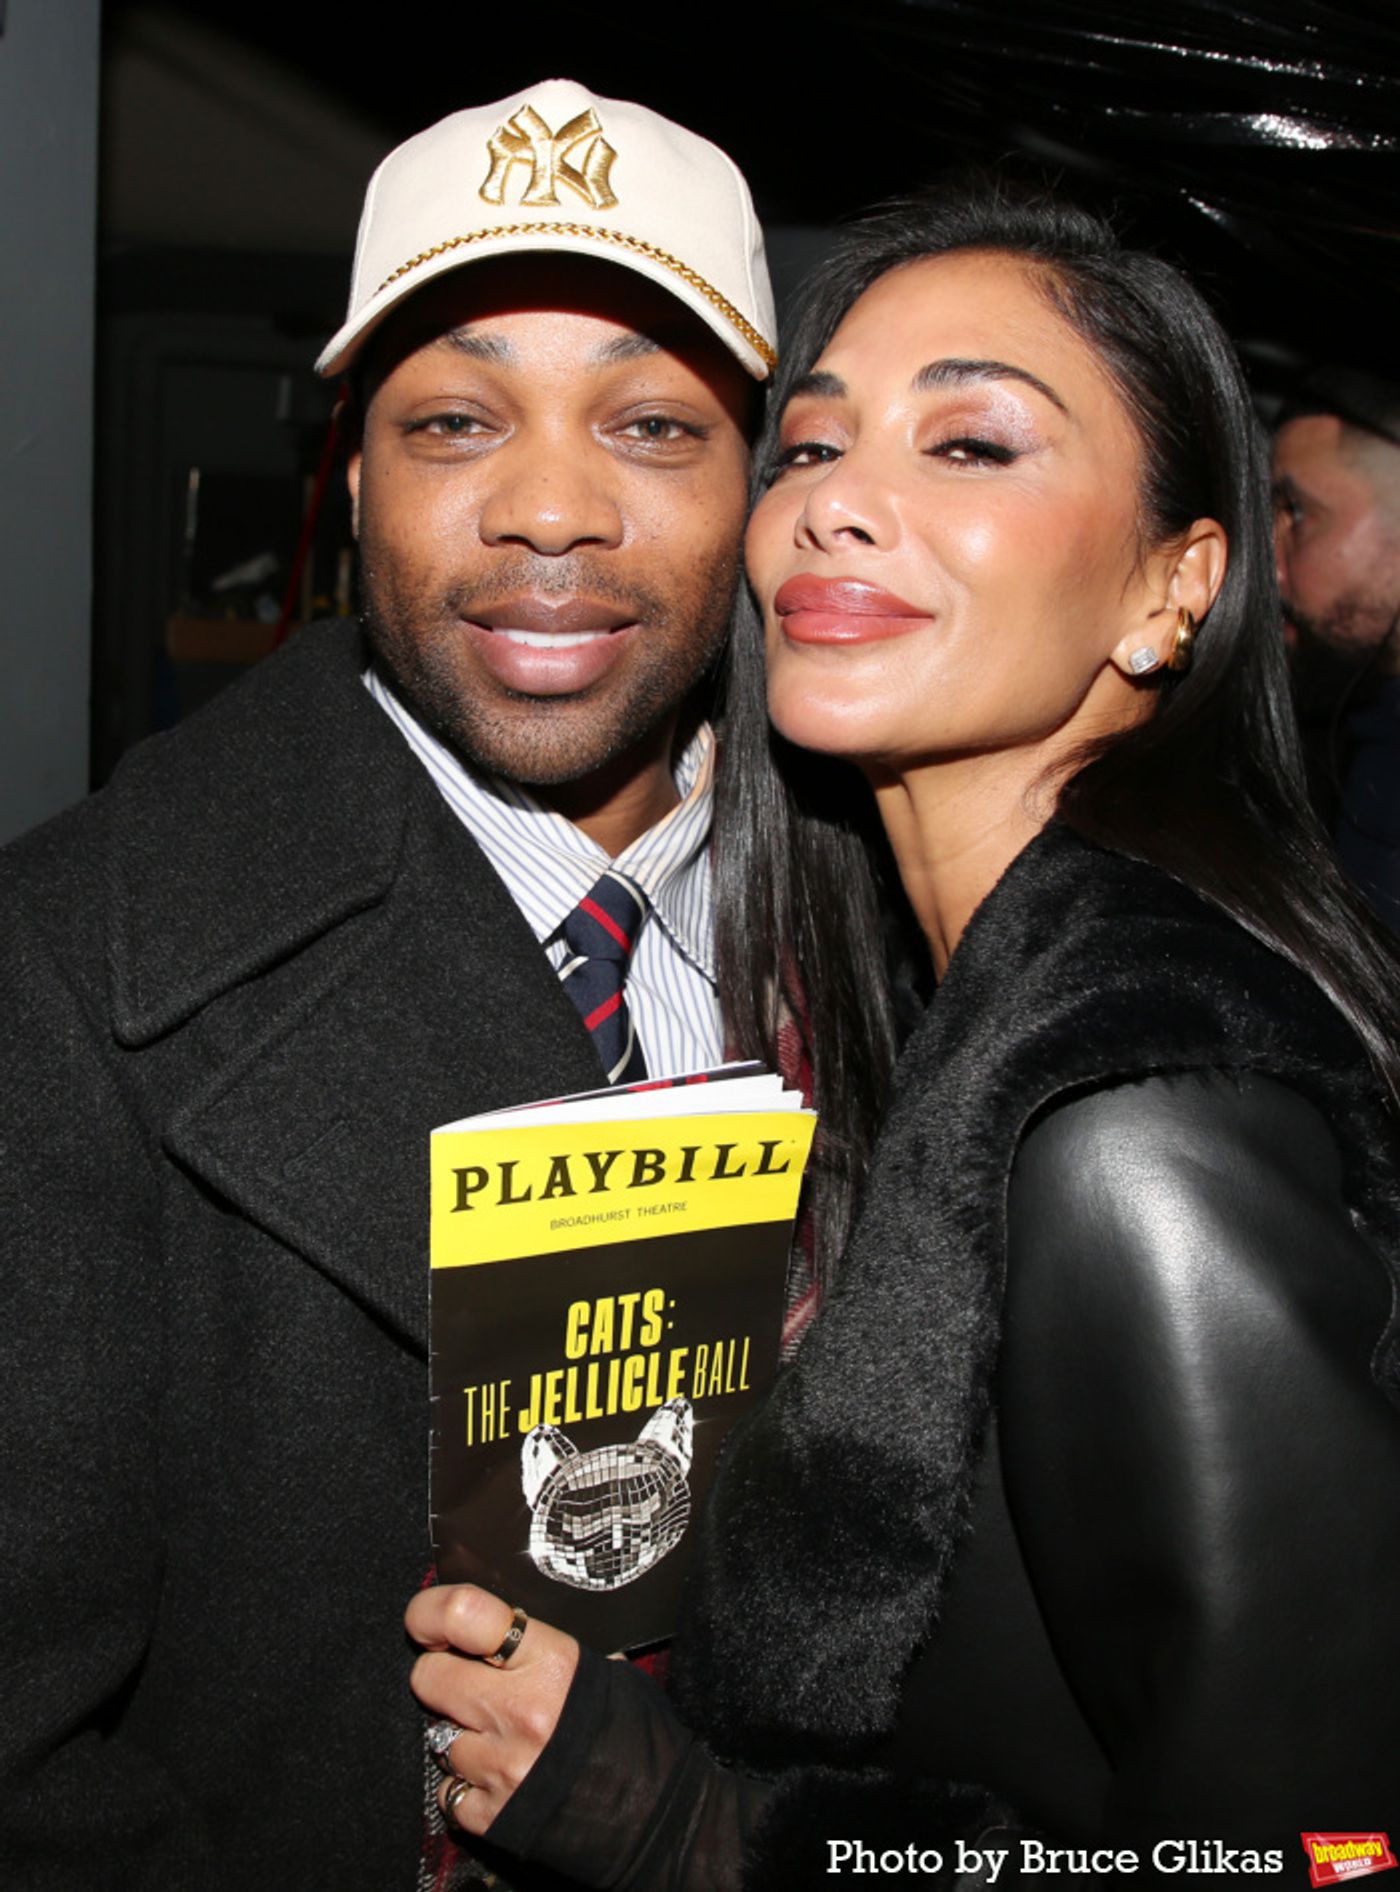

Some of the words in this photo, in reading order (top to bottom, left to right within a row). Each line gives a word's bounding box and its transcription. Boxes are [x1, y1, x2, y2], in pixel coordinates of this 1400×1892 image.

[450, 1139, 792, 1214] PLAYBILL
[549, 1208, 631, 1231] BROADHURST
[637, 1201, 688, 1219] THEATRE
[565, 1288, 676, 1361] CATS:
[464, 1380, 512, 1447] THE
[518, 1346, 690, 1434] JELLICLE
[692, 1336, 751, 1400] BALL
